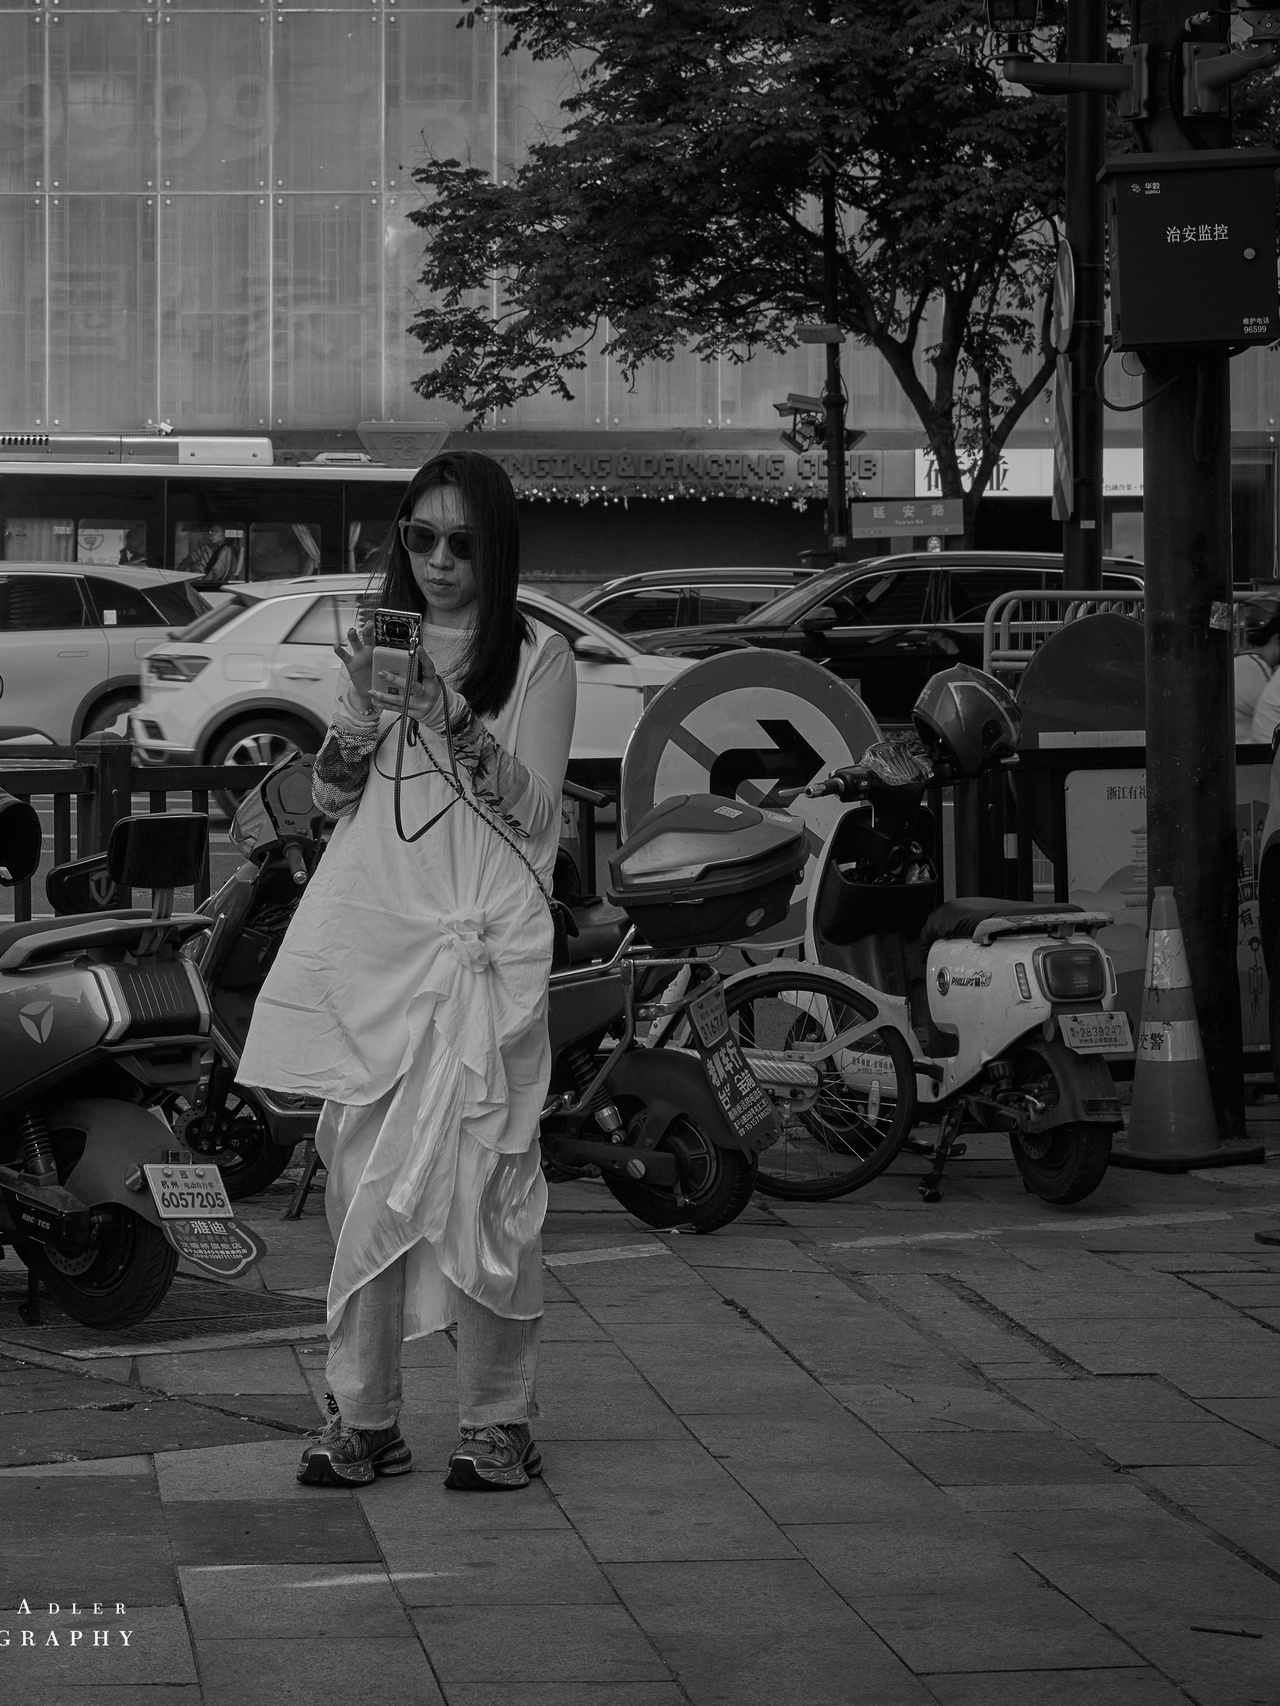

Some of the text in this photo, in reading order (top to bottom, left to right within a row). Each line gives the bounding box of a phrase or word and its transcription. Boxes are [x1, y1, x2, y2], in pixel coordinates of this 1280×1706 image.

[1166, 224, 1229, 243] 治安监控
[1244, 326, 1267, 334] 96599
[490, 454, 784, 479] INGING&DANCING
[873, 504, 944, 518] 延安路
[1106, 786, 1147, 800] 浙江有礼
[1080, 1025, 1121, 1038] 2839247
[1139, 1032, 1164, 1050] 交警
[160, 1180, 179, 1189] 杭州
[161, 1192, 225, 1208] 6057205
[38, 1219, 50, 1229] TCS
[190, 1221, 228, 1235] 雅迪
